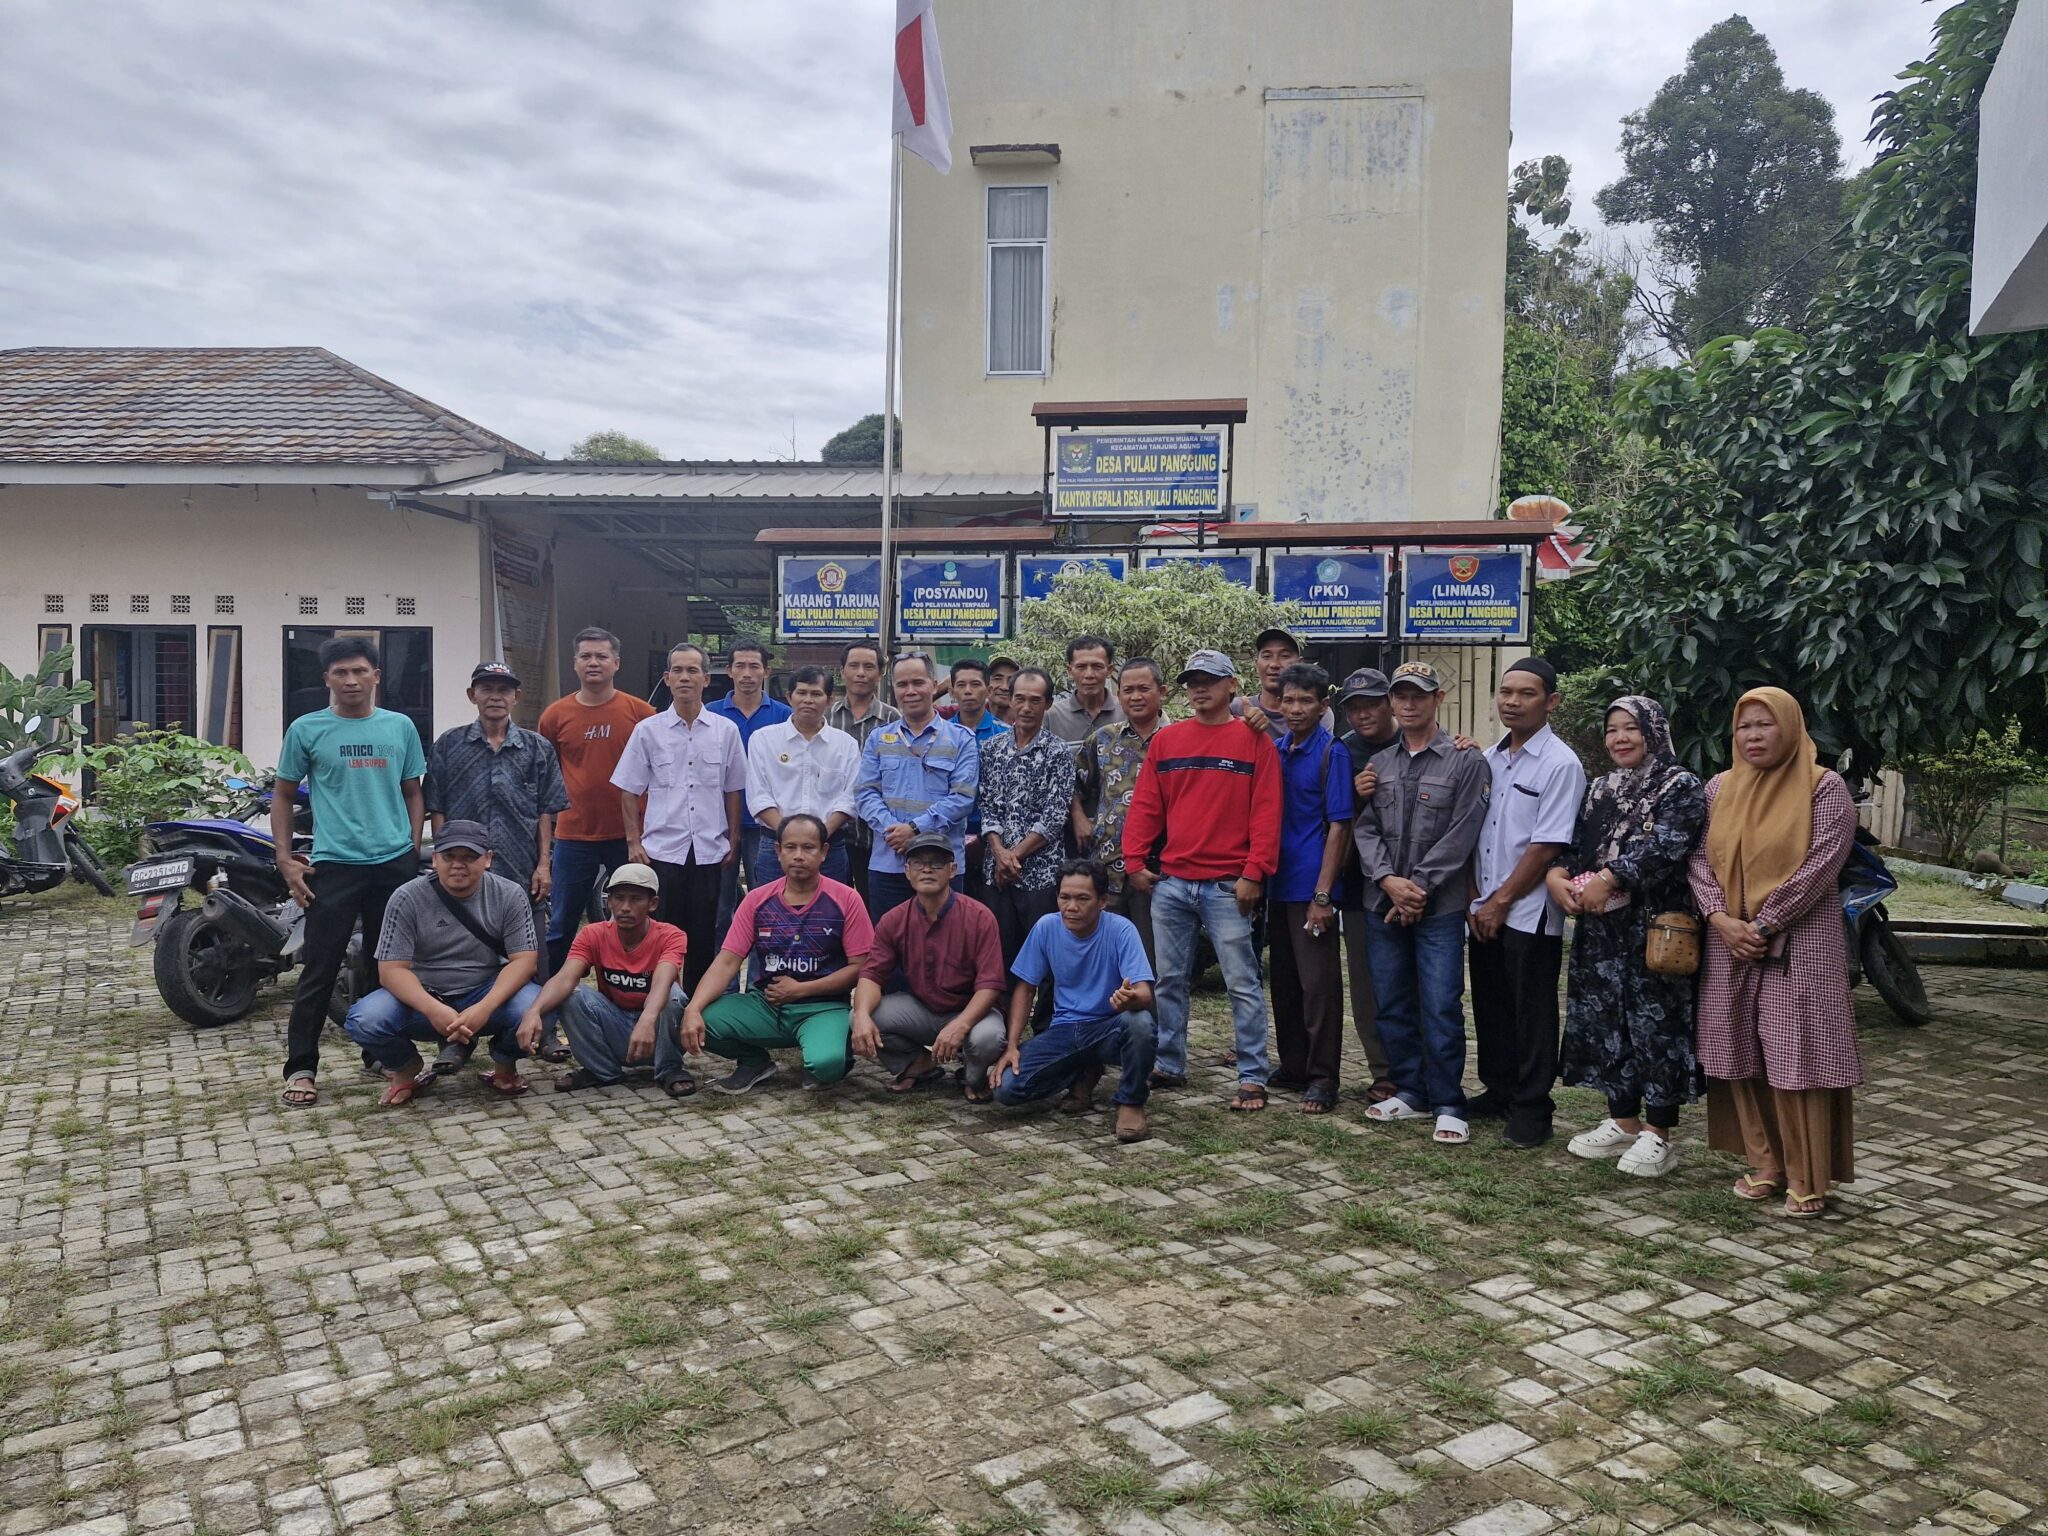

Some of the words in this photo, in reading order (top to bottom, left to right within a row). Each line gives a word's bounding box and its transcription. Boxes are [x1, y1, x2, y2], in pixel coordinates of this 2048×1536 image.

[1095, 456, 1122, 474] DESA
[1124, 455, 1158, 473] PULAU
[1160, 454, 1217, 472] PANGGUNG
[1059, 490, 1091, 508] KANTOR
[1092, 489, 1122, 507] KEPALA
[1123, 489, 1144, 507] DESA
[1145, 489, 1171, 507] PULAU
[1172, 488, 1217, 506] PANGGUNG
[913, 587, 989, 602] (POSYANDU)
[1308, 585, 1349, 599] (PKK)
[1432, 584, 1495, 600] (LINMAS)
[784, 594, 832, 608] KARANG
[834, 594, 880, 608] TARUNA
[786, 608, 807, 619] DESA
[807, 608, 834, 619] PULAU
[834, 608, 879, 619] PANGGUNG
[903, 608, 925, 620] DESA
[925, 608, 952, 620] PULAU
[953, 608, 998, 620] PANGGUNG
[1331, 606, 1381, 617] PANGGUNG
[1409, 607, 1433, 618] DESA
[1434, 607, 1465, 618] PULAU
[1466, 607, 1517, 618] PANGGUNG
[340, 744, 373, 757] ARTICO
[778, 957, 818, 972] blibli
